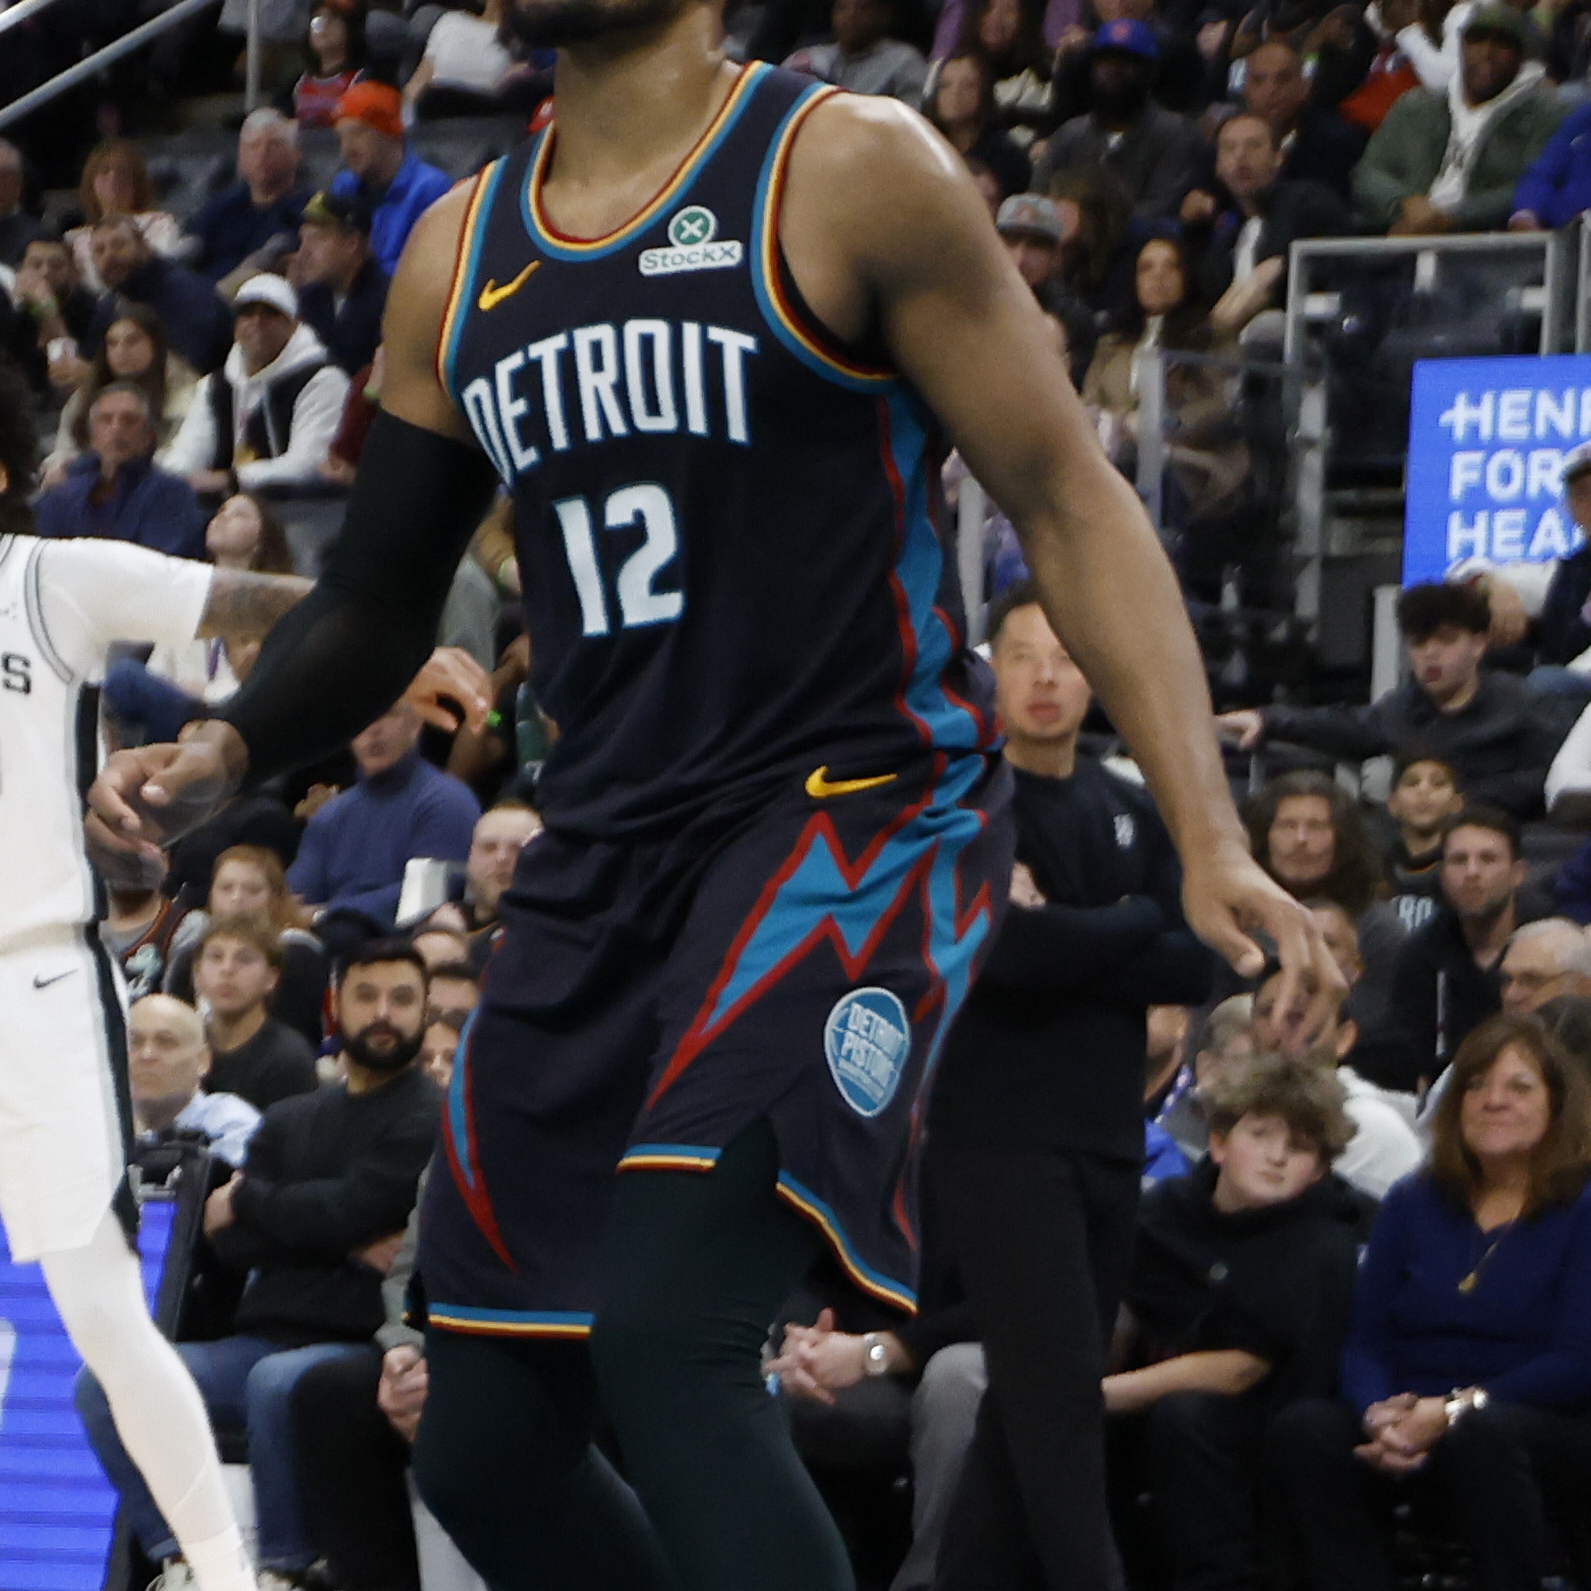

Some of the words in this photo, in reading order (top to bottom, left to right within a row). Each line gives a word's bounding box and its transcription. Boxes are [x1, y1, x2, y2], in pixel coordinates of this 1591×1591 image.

[643, 245, 737, 271] StockX
[462, 317, 757, 491] DETROIT
[554, 482, 685, 637] 12
